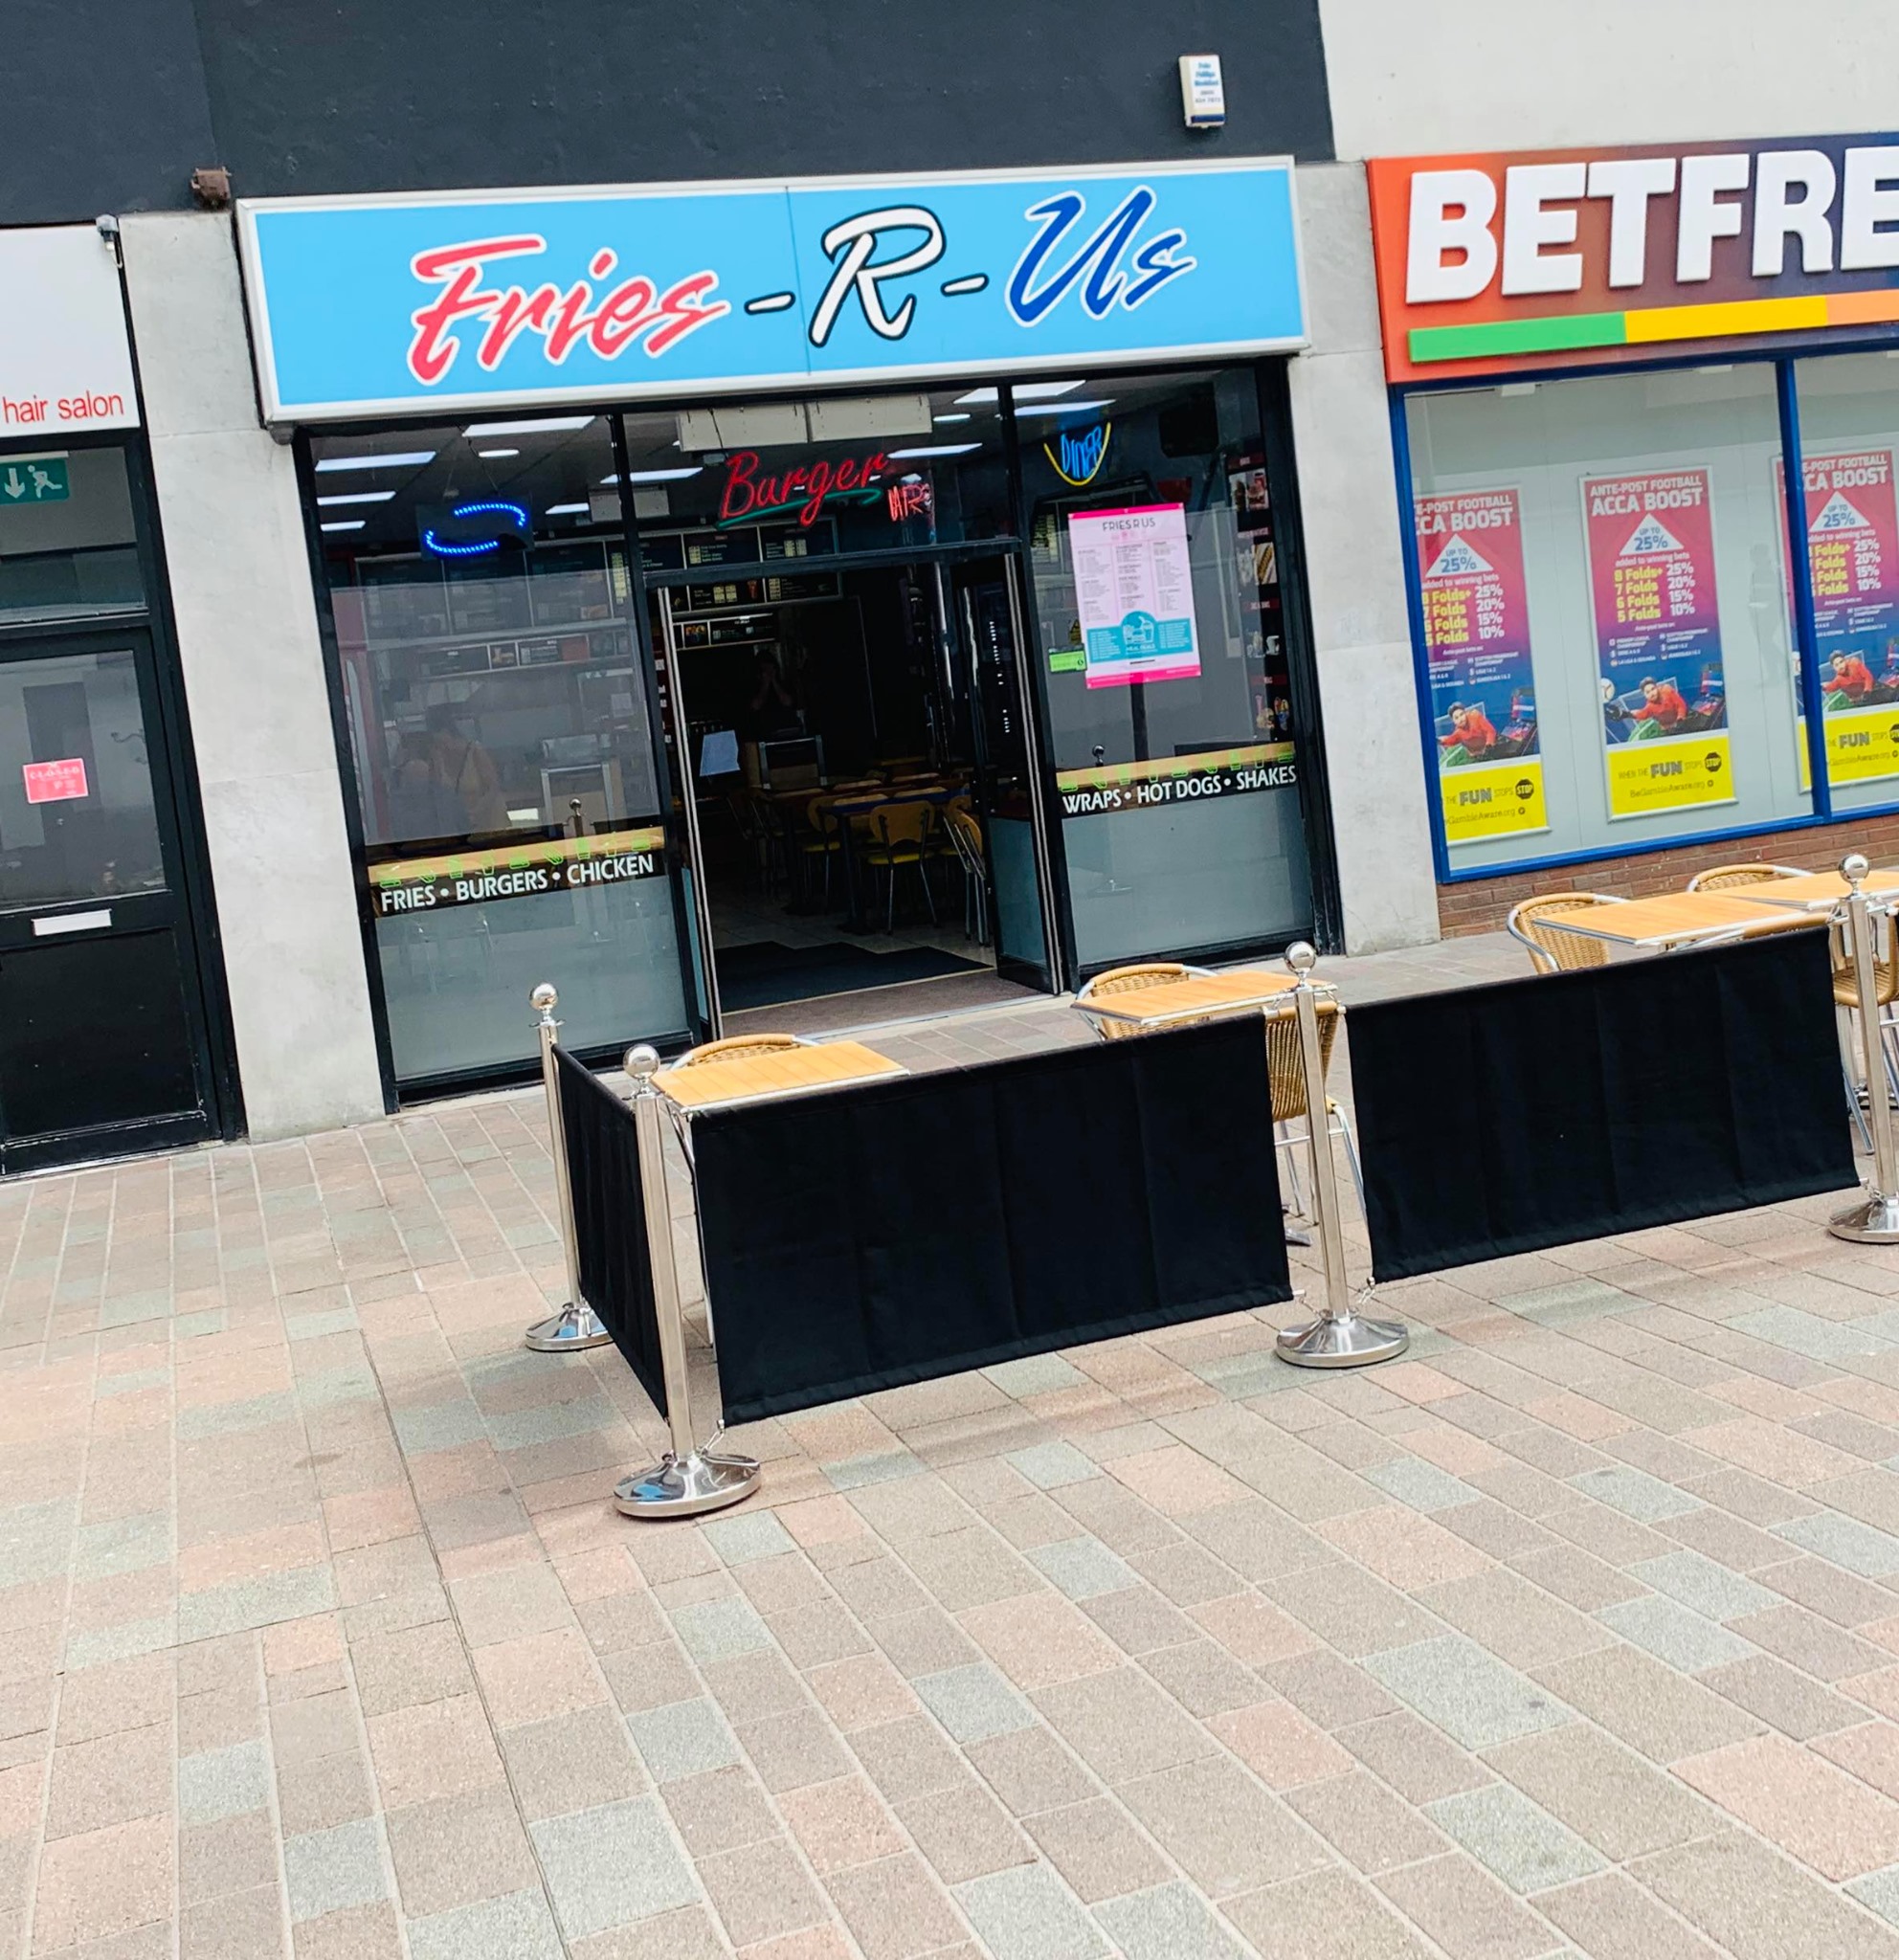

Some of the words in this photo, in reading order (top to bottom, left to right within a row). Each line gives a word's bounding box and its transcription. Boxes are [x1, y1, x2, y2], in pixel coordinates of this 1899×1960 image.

[1405, 145, 1899, 304] BETFRE
[3, 394, 48, 423] hair
[57, 390, 123, 419] salon
[1802, 460, 1836, 473] E-POST
[1838, 454, 1887, 469] FOOTBALL
[1591, 481, 1648, 497] ANTE-POST
[1650, 476, 1702, 490] FOOTBALL
[1833, 466, 1888, 489] BOOST
[719, 450, 889, 526] Burger
[1415, 501, 1454, 515] E-POST
[1458, 495, 1512, 510] FOOTBALL
[1592, 496, 1640, 516] ACCA
[1644, 487, 1703, 510] BOOST
[1103, 520, 1131, 532] FRIES
[1133, 519, 1139, 528] R
[1141, 518, 1155, 527] US
[1451, 507, 1513, 531] BOOST
[1823, 513, 1855, 527] 25%
[1634, 535, 1667, 551] 25%
[1853, 539, 1880, 552] 25%
[1441, 556, 1476, 572] 25%
[1616, 557, 1636, 567] added
[1647, 553, 1672, 563] winning
[1816, 557, 1845, 569] Folds
[1855, 552, 1881, 566] 20%
[1455, 576, 1482, 586] winning
[1615, 570, 1622, 582] 8
[1666, 562, 1694, 576] 25%
[1817, 570, 1847, 583] Folds
[1856, 566, 1880, 578] 15%
[1475, 584, 1504, 598] 25%
[1615, 584, 1622, 595] 7
[1626, 580, 1658, 593] Folds
[1667, 576, 1695, 590] 20%
[1819, 584, 1848, 596] Folds
[1857, 578, 1881, 591] 10%
[1433, 603, 1465, 616] Folds
[1476, 598, 1505, 612] 20%
[1617, 596, 1624, 608] 6
[1628, 594, 1660, 607] Folds
[1669, 589, 1694, 602] 15%
[1434, 616, 1468, 631] Folds
[1478, 612, 1503, 626] 15%
[1618, 611, 1625, 622] 5
[1629, 608, 1661, 621] Folds
[1670, 603, 1695, 616] 10%
[1436, 631, 1469, 645] Folds
[1478, 626, 1505, 639] 10%
[1839, 731, 1869, 748] FUN
[1638, 768, 1648, 776] THE
[1651, 761, 1683, 778] FUN
[1706, 758, 1721, 768] STOP
[1062, 789, 1122, 813] WRAPS
[1137, 782, 1172, 804] HOT
[1176, 775, 1221, 798] DOGS
[1236, 766, 1297, 791] SHAKES
[1459, 787, 1492, 806] FUN
[1516, 783, 1533, 795] STOP
[1445, 808, 1515, 825] GambleAware.org
[381, 885, 436, 912] FRIES
[456, 869, 547, 902] BURGERS
[567, 854, 654, 884] CHICKEN
